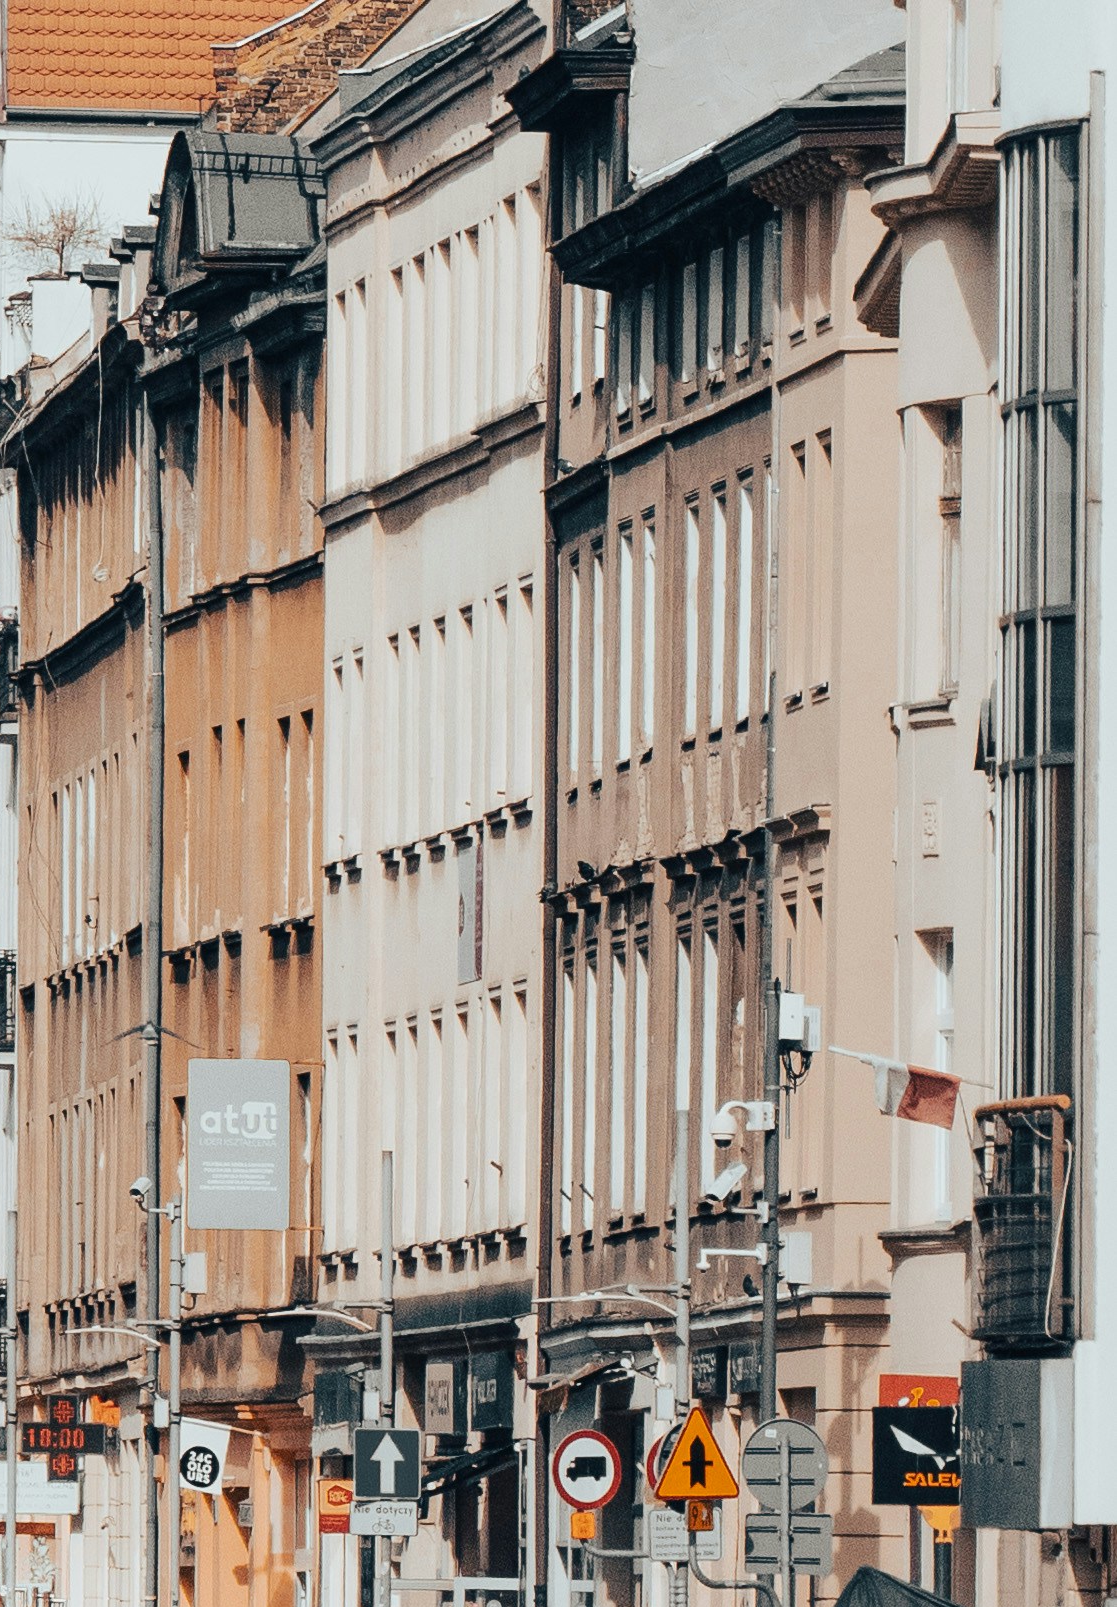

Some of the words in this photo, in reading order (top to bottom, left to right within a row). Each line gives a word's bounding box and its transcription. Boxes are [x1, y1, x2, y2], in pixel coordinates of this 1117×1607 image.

[200, 1102, 277, 1139] atut
[188, 1450, 213, 1465] 24C
[186, 1460, 213, 1475] OLO
[186, 1470, 211, 1485] URS
[353, 1504, 371, 1514] Nie
[376, 1504, 414, 1517] dotyczy
[656, 1514, 672, 1523] Nie
